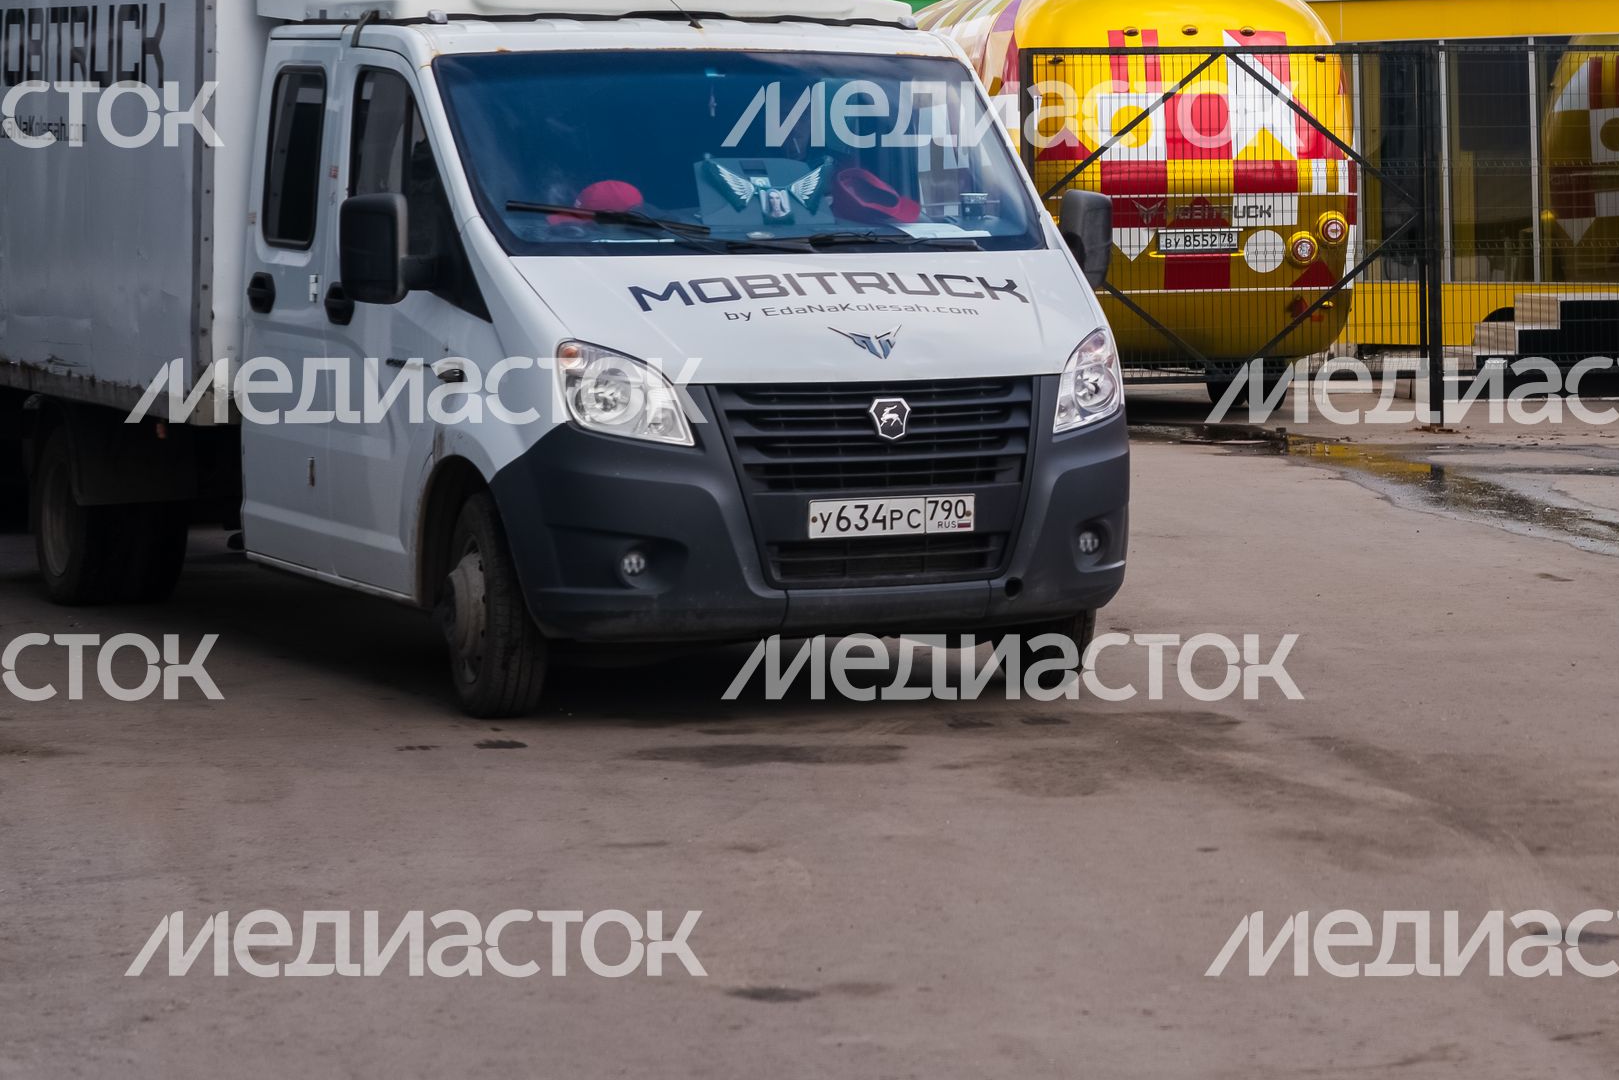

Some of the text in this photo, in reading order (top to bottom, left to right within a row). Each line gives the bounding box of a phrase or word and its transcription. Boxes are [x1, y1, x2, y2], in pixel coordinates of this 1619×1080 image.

[0, 3, 166, 89] OBITRUCK
[627, 271, 1030, 312] MOBITRUCK
[724, 302, 980, 321] by EdaNaKolesah.com
[927, 499, 967, 521] 790
[937, 521, 957, 529] RUS
